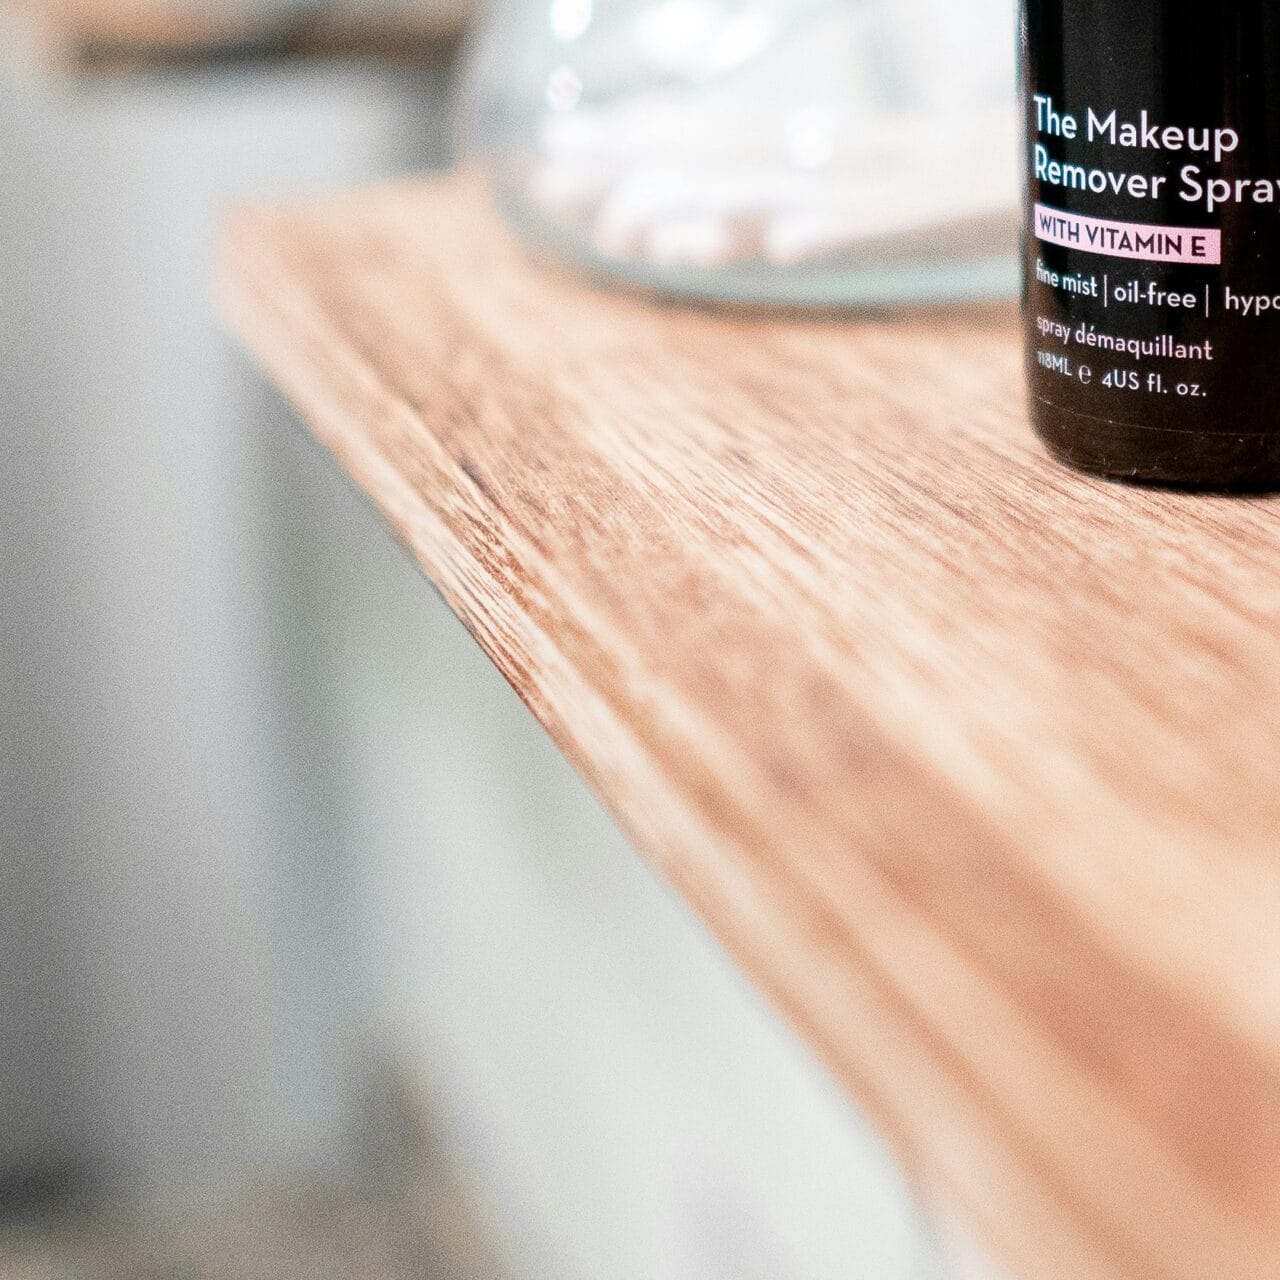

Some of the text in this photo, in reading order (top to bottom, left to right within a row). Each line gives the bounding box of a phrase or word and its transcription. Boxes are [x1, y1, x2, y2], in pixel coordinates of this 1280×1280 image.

[1034, 95, 1239, 162] The Makeup
[1034, 144, 1166, 199] Remover
[1039, 212, 1206, 257] WITH VITAMIN E
[1062, 274, 1098, 297] mist
[1114, 282, 1197, 308] oil-free
[1036, 314, 1213, 363] spray démaquillant
[1101, 372, 1140, 391] 4US
[1146, 374, 1168, 394] fl.
[1176, 381, 1207, 397] oz.
